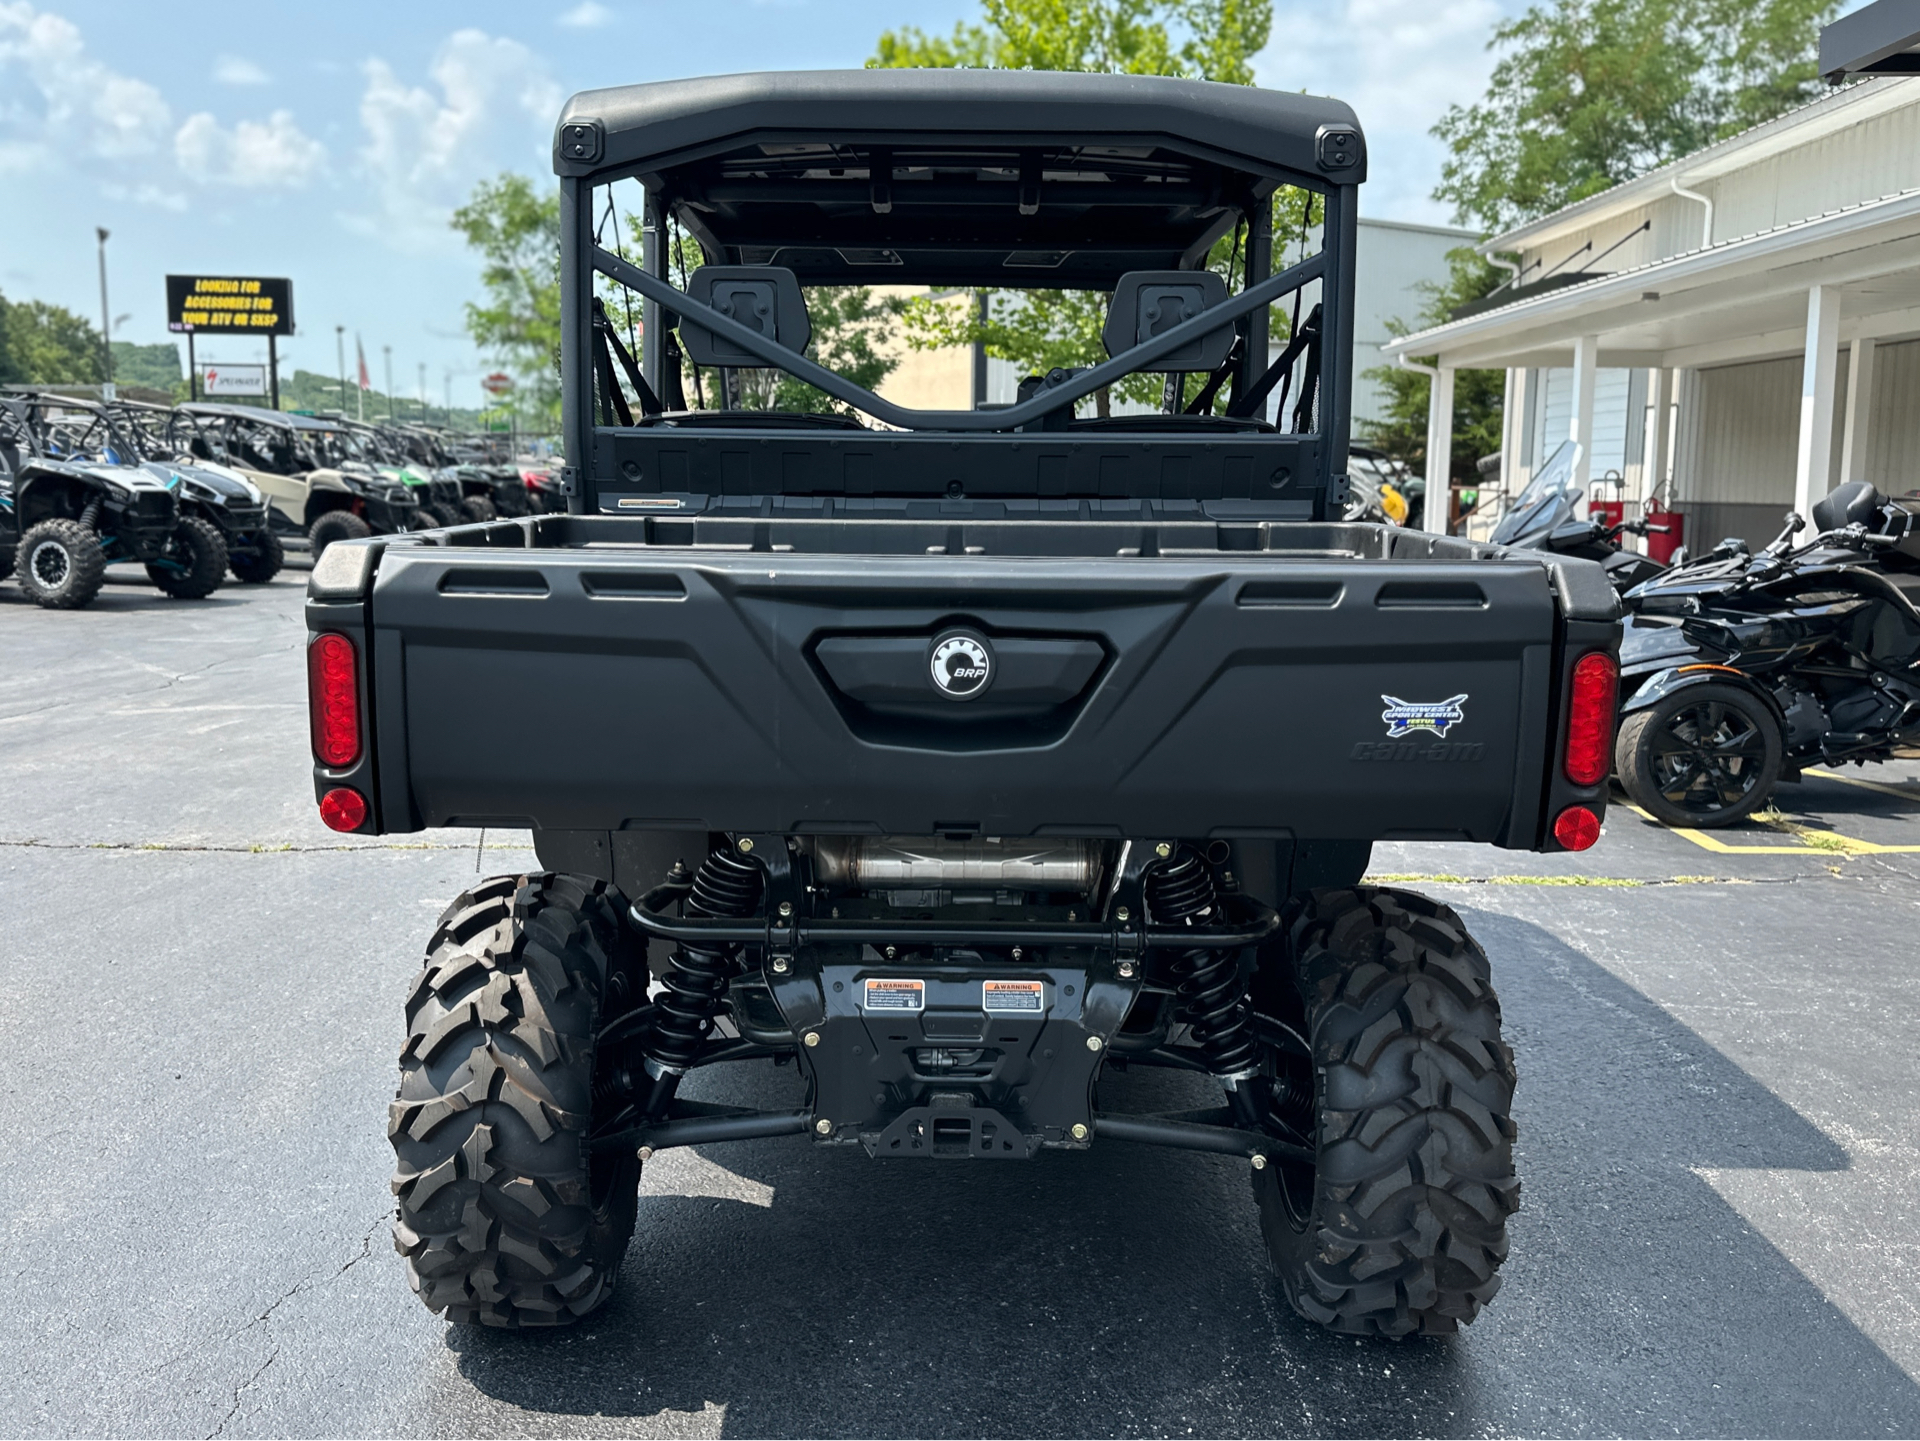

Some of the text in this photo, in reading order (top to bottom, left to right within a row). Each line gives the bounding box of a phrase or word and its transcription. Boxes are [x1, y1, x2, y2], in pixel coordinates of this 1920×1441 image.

[195, 279, 261, 294] LOOKING FOR
[185, 296, 273, 311] ACCESSORIES FOR
[182, 312, 209, 325] YOUR
[210, 312, 232, 325] ATV
[234, 313, 249, 326] OR
[954, 668, 985, 678] BRP
